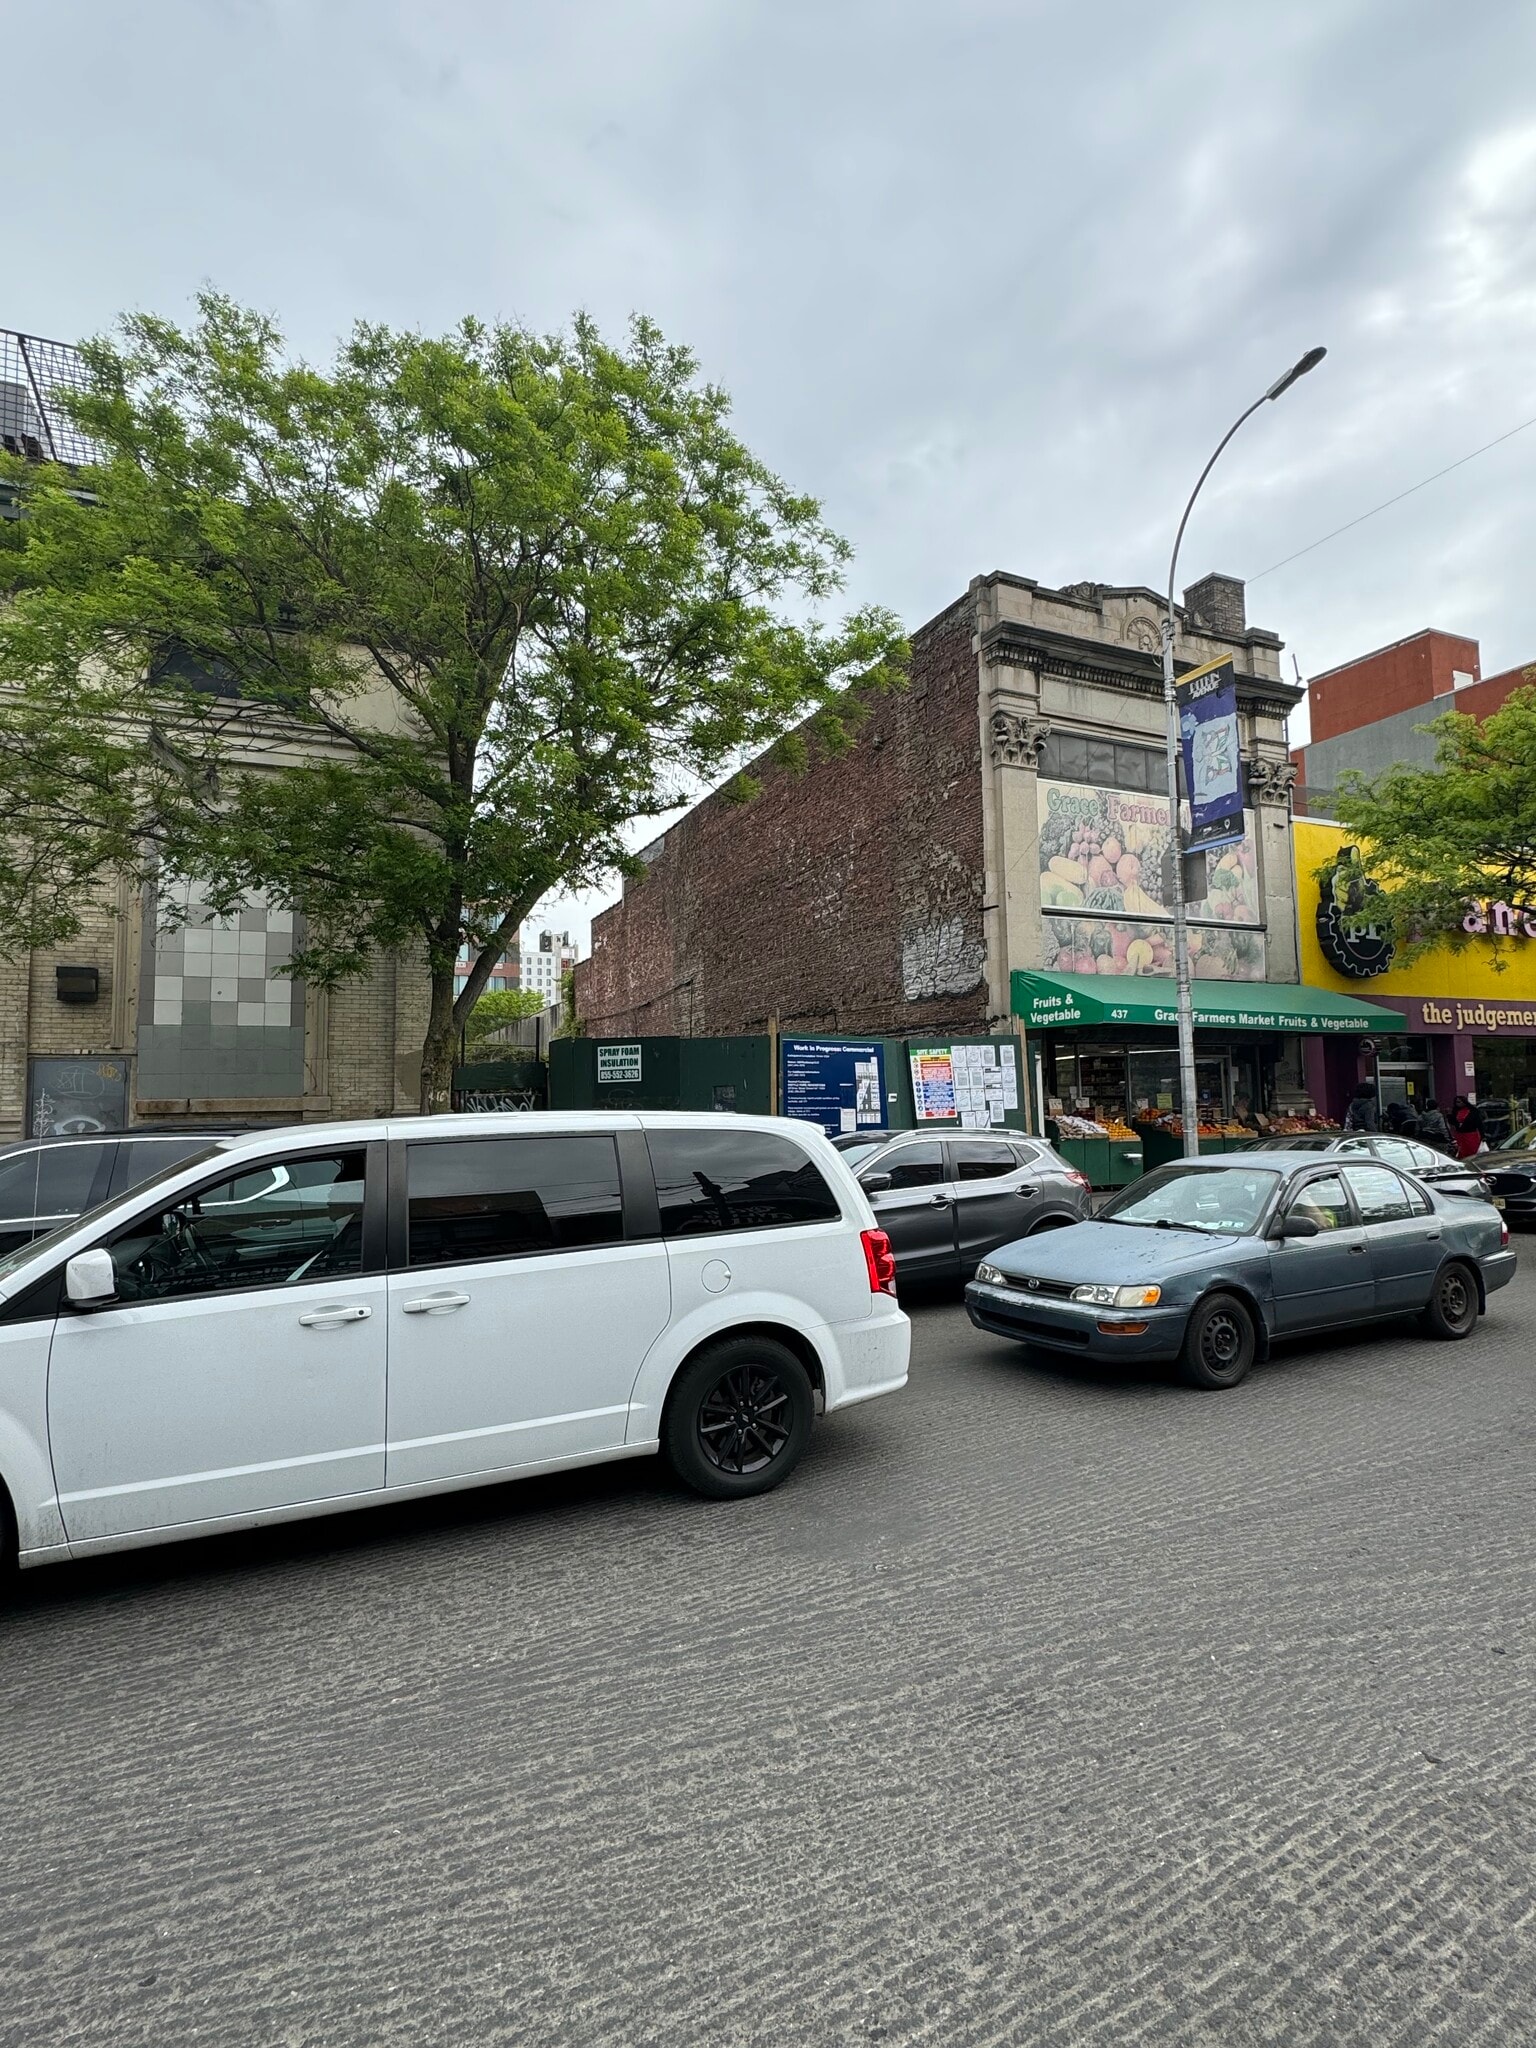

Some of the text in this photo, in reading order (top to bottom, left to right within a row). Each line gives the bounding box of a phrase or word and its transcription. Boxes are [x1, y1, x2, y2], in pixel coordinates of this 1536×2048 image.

[1047, 788, 1099, 816] Grace
[1033, 993, 1074, 1009] Fruits &
[1030, 1008, 1081, 1025] Vegetable
[1111, 1009, 1128, 1019] 437
[1154, 1009, 1368, 1031] Grac Farmers Market Fruits & Vegetable
[1422, 1002, 1453, 1024] the
[600, 1046, 639, 1057] SPRAY FOAM
[793, 1044, 808, 1052] Work
[600, 1058, 639, 1067] INSULATION
